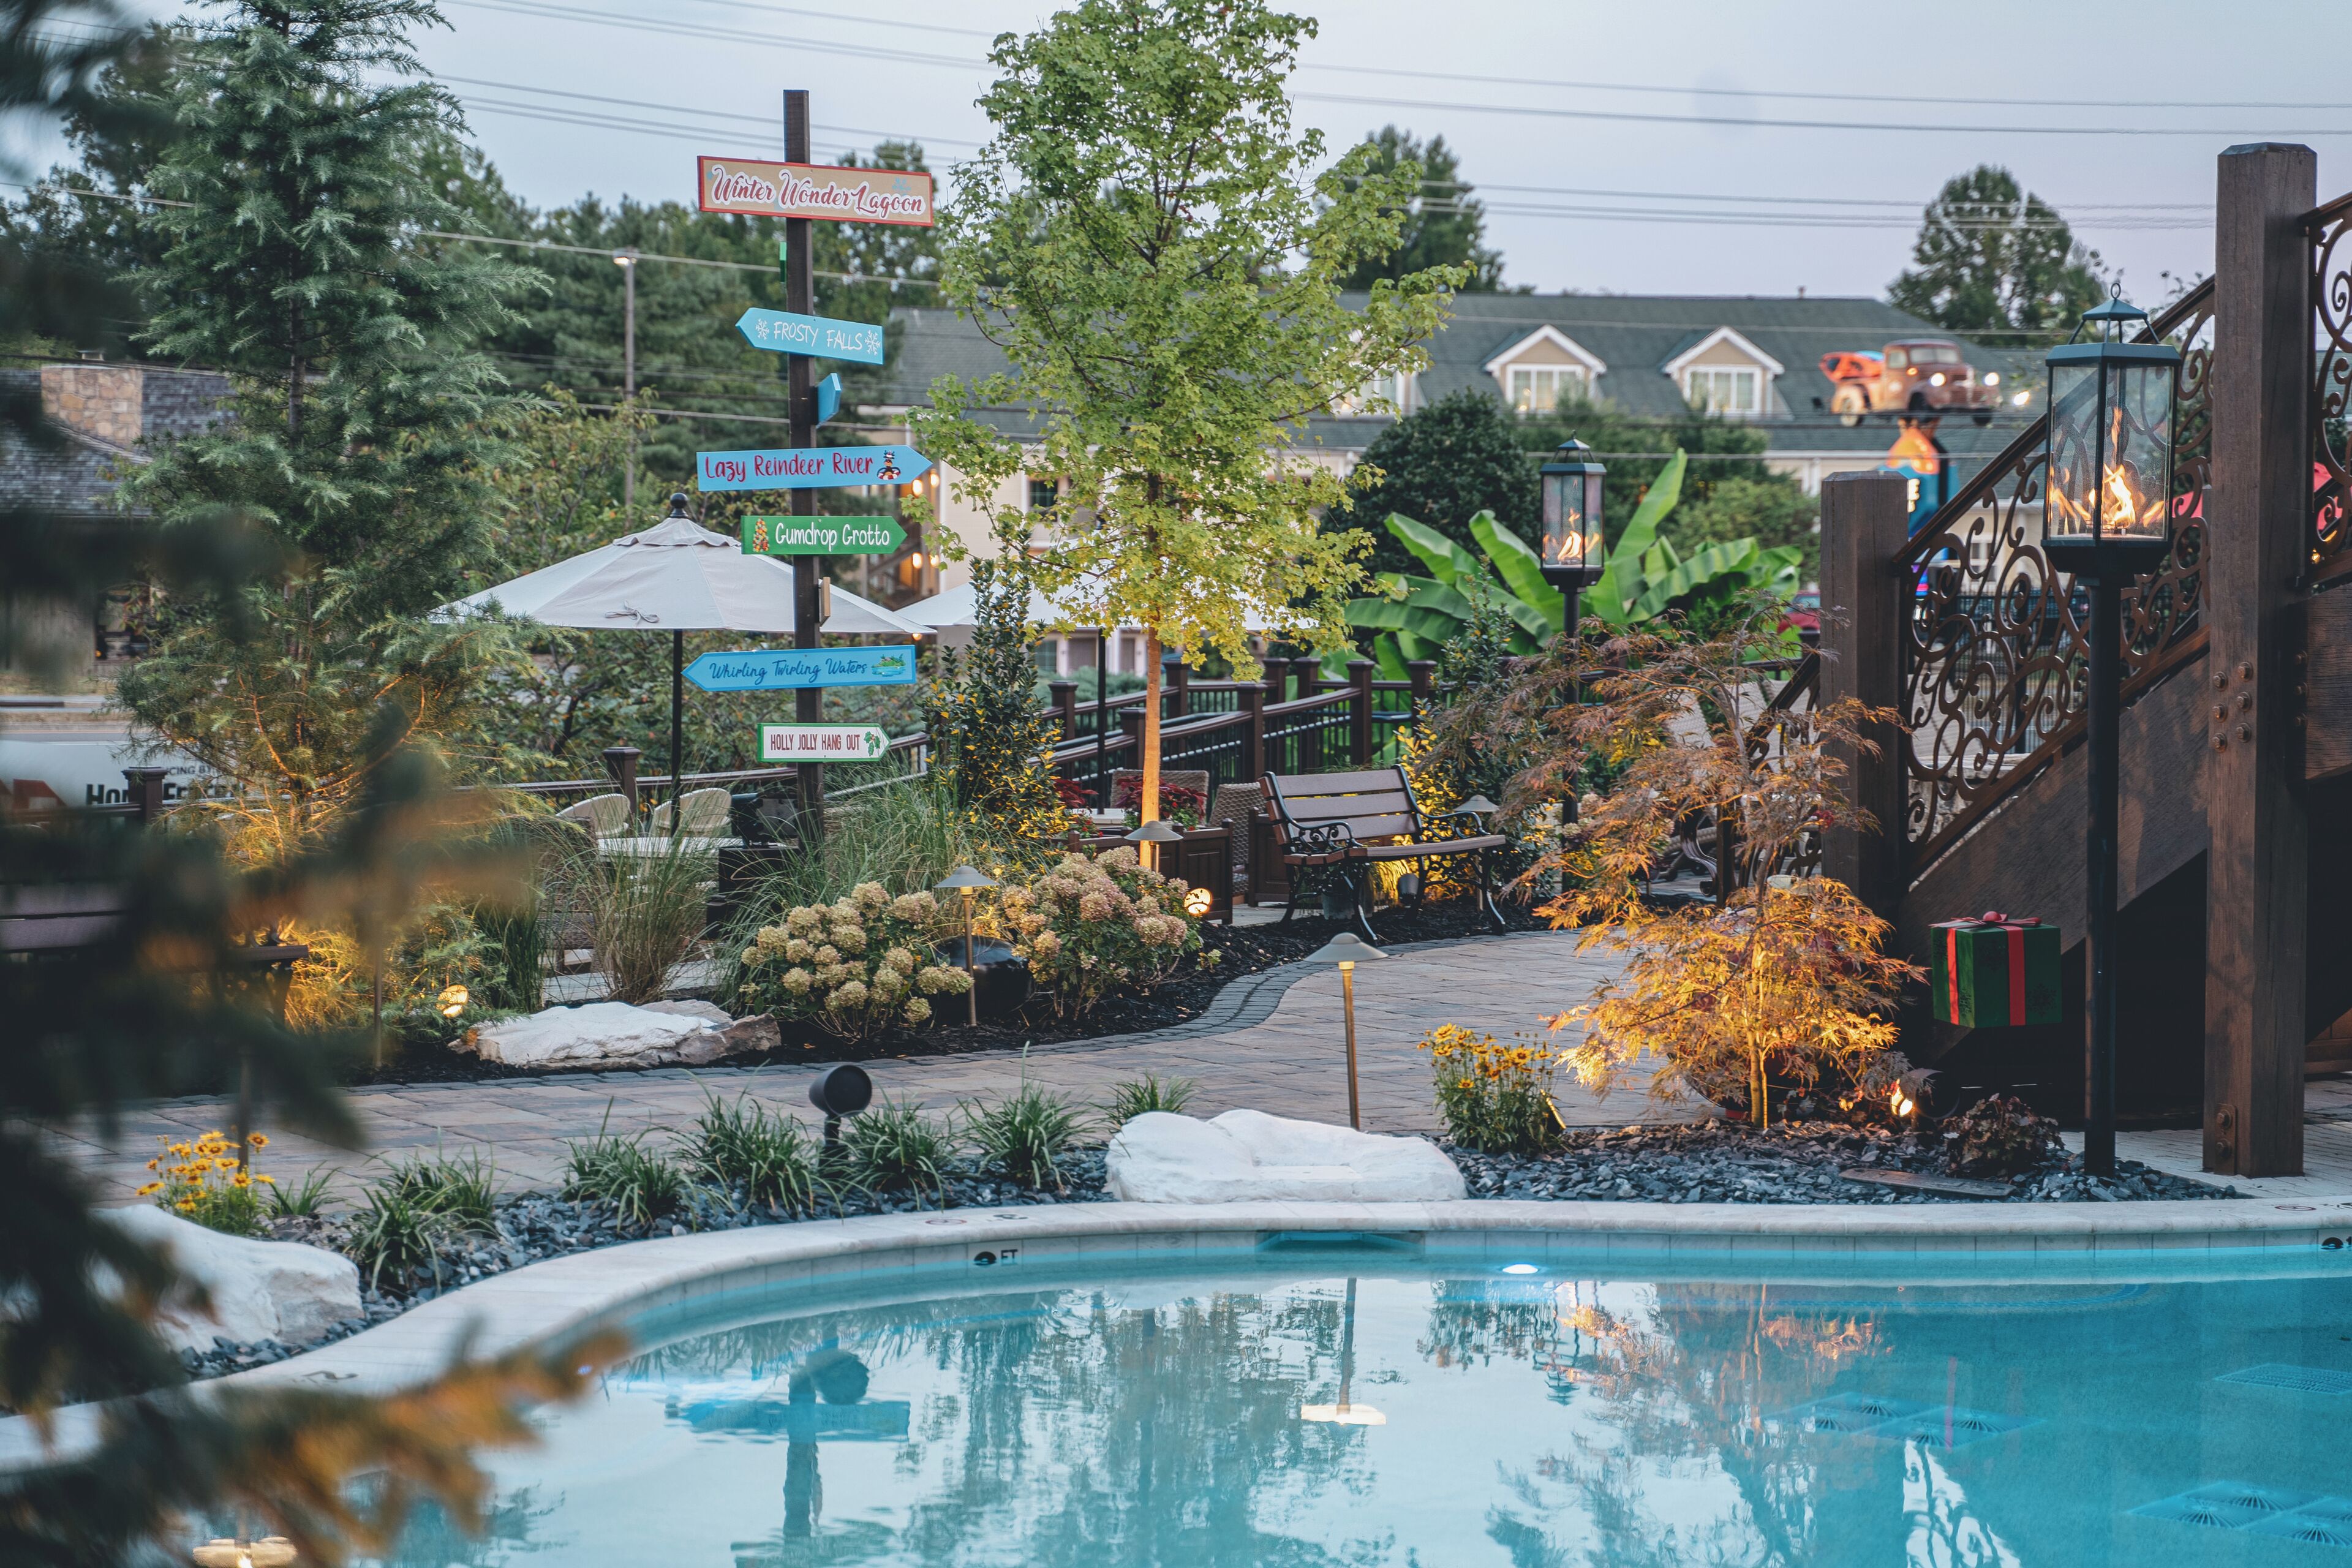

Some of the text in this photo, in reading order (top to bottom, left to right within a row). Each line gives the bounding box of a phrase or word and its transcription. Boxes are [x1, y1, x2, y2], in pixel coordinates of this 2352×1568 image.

[713, 166, 924, 218] Winter Wonder Lagoon
[774, 322, 863, 350] FROSTY FALLS
[705, 452, 873, 483] Lazy Reindeer River
[775, 522, 890, 551] Gumdrop Grotto
[709, 658, 867, 685] Whirling Twirling Waters
[771, 733, 861, 751] HOLLY JOLLY HANG OUT
